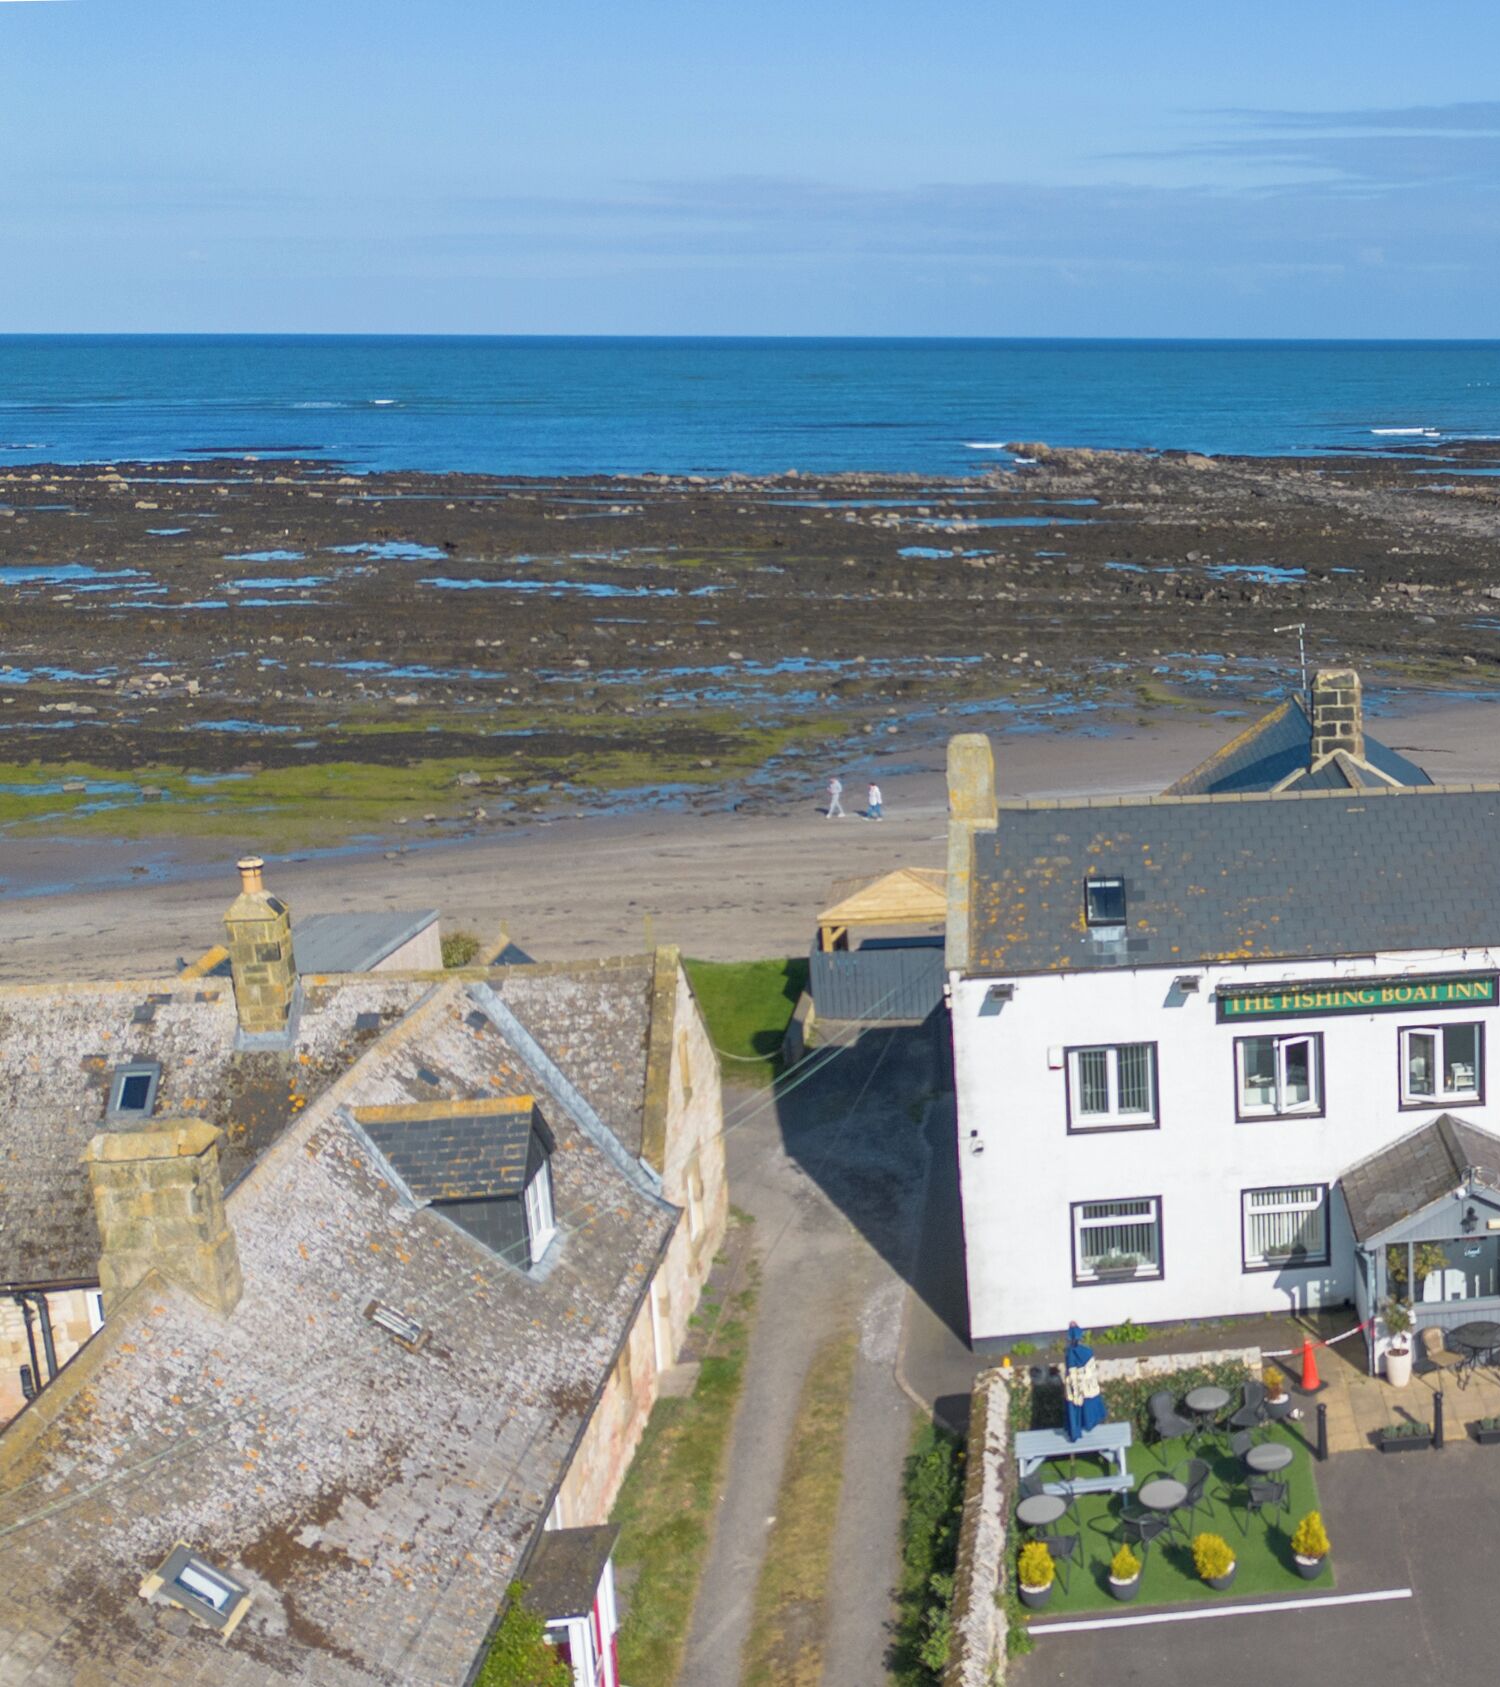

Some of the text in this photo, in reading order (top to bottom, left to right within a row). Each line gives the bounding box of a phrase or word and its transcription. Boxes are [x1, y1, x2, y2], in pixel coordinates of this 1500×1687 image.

[1231, 980, 1489, 1012] THE FISHING BOAT INN
